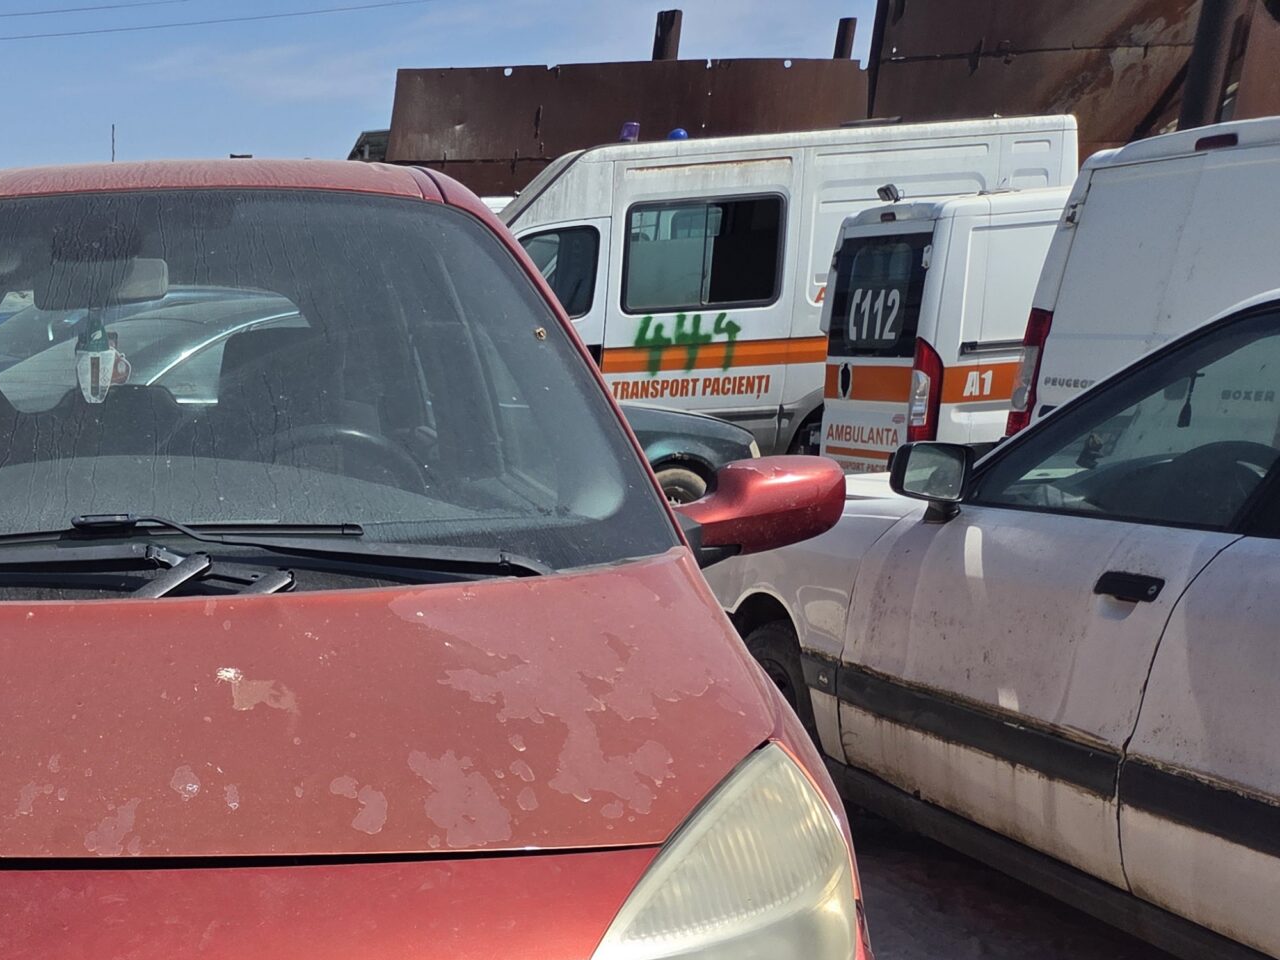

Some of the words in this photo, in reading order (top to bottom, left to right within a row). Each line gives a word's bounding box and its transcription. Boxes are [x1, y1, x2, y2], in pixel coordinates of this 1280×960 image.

[612, 378, 699, 400] TRANSPORT
[963, 370, 993, 397] A1
[1221, 390, 1275, 402] BOXER
